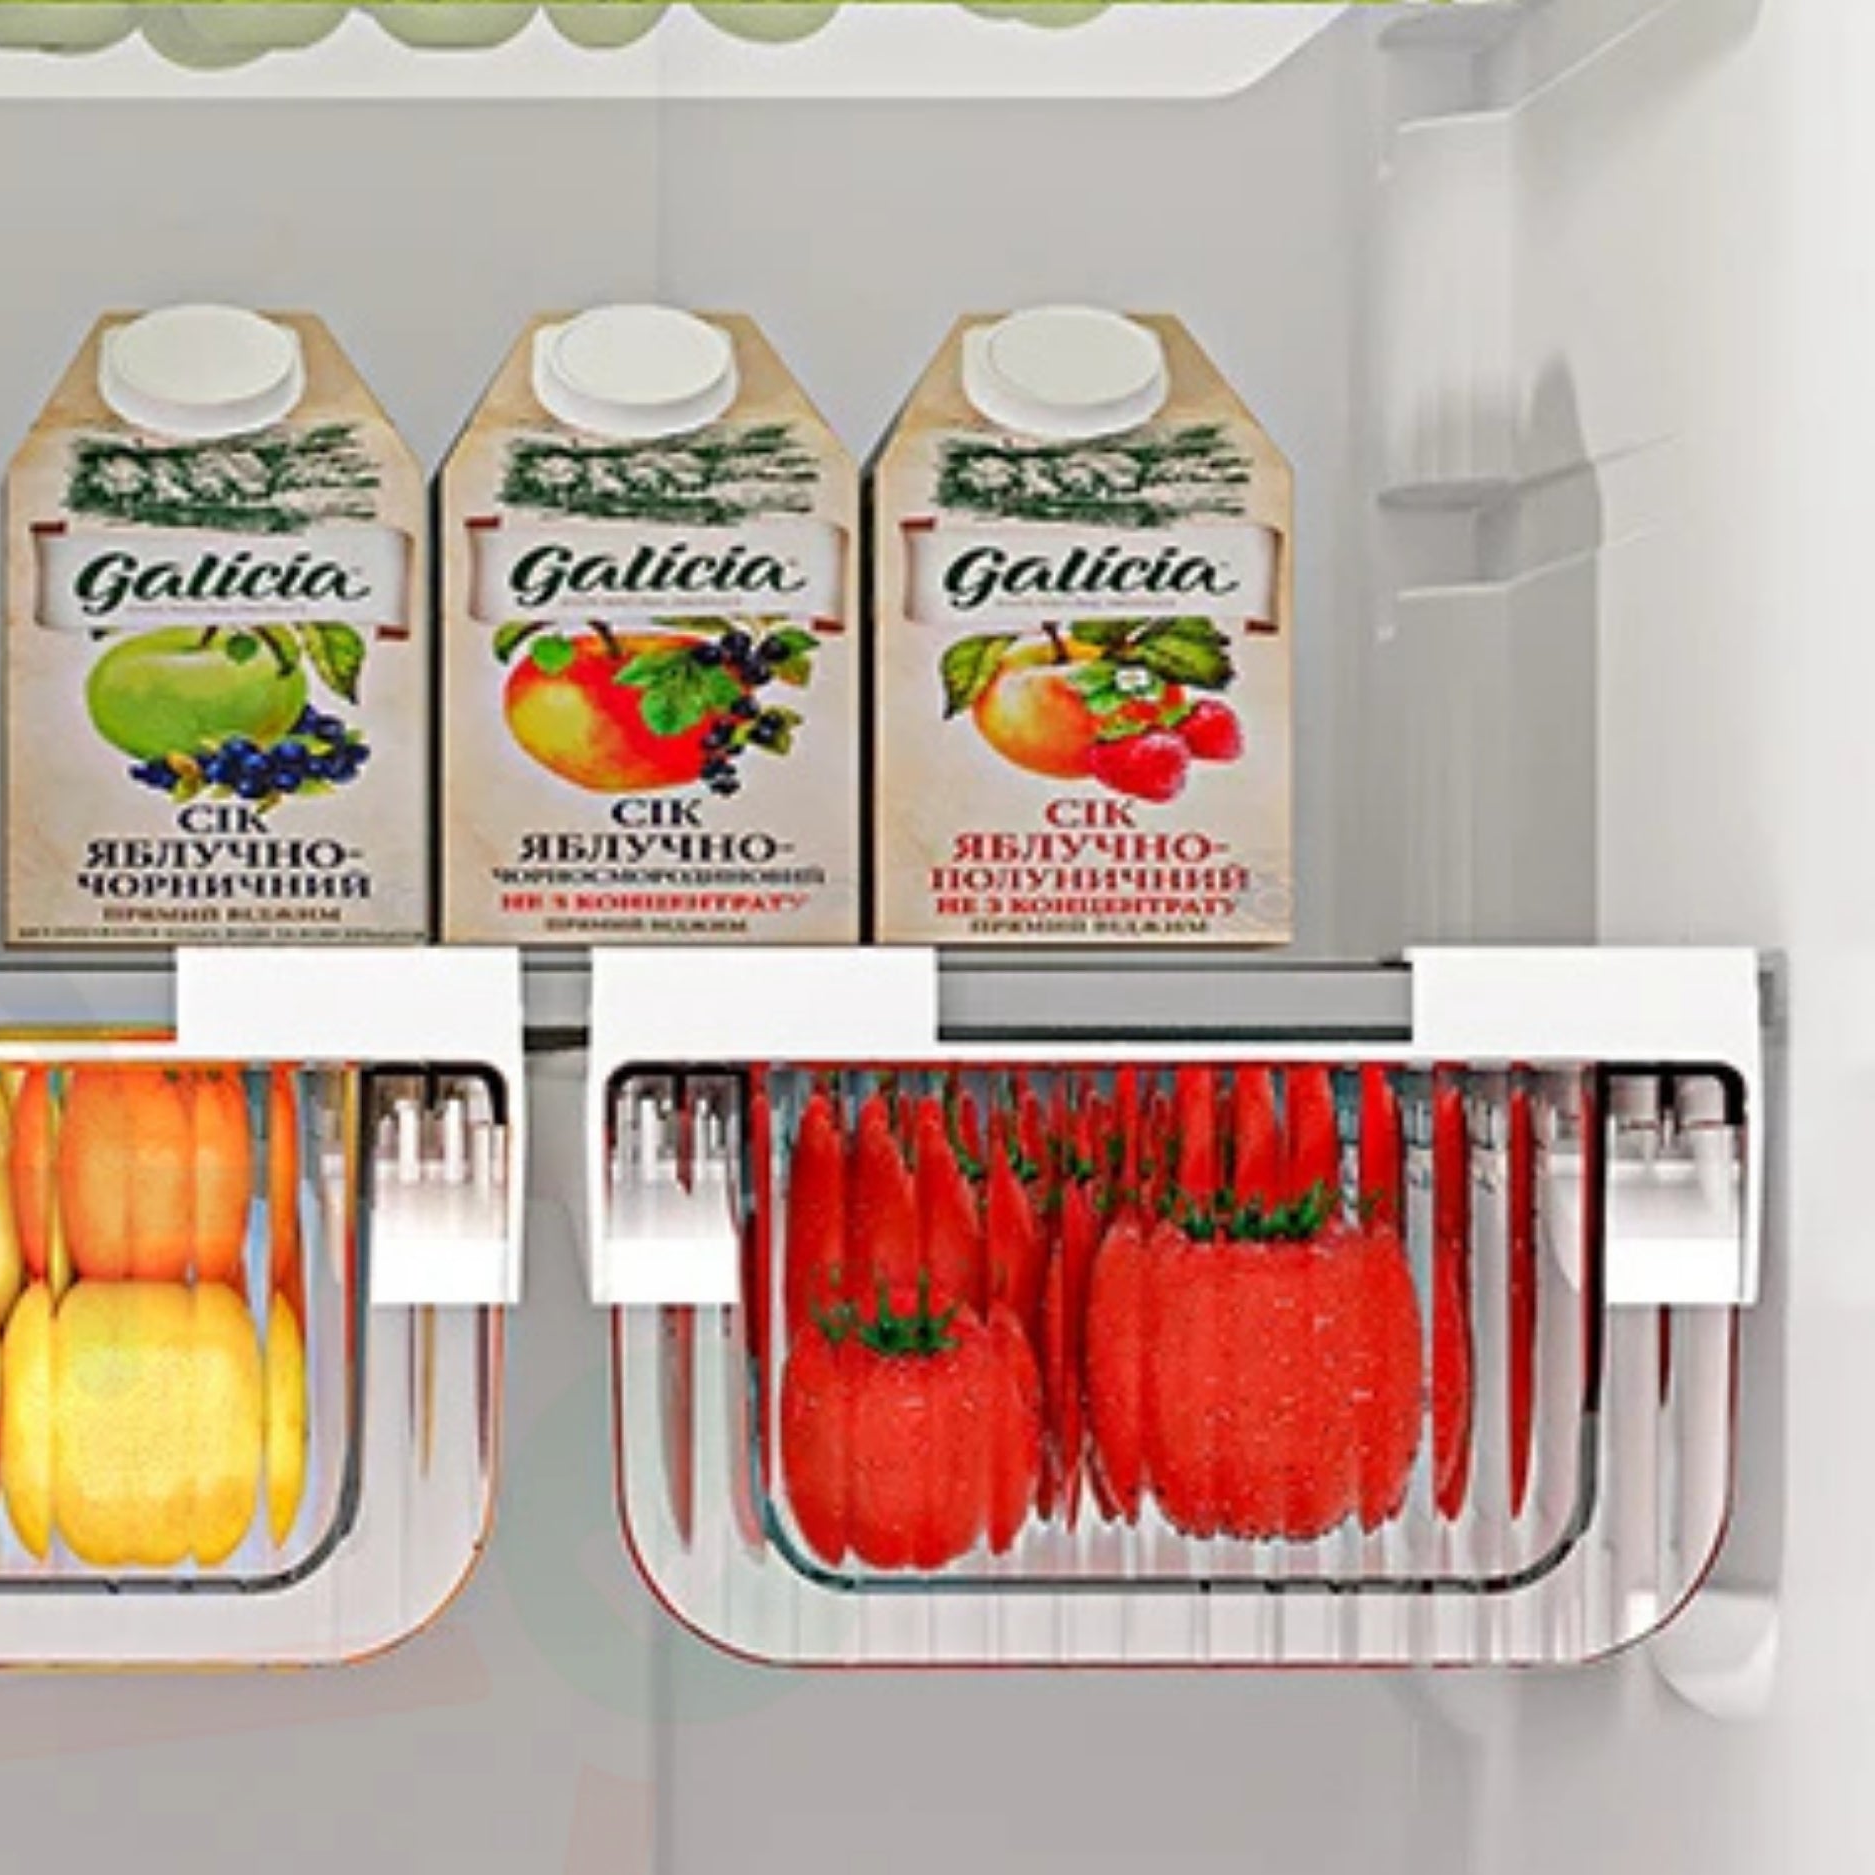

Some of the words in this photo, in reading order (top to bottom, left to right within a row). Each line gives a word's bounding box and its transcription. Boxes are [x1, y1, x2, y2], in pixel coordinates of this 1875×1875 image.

[74, 551, 371, 615] Galicia
[509, 544, 806, 607] Galicia
[943, 544, 1240, 609] Galicia
[177, 805, 270, 834] СІК
[611, 799, 703, 828] СІК
[1044, 800, 1136, 828] СІК
[87, 839, 362, 869] ЯБЛУЧНО-
[519, 833, 794, 863] ЯБЛУЧНО-
[953, 833, 1229, 863] ЯБЛУЧНО-
[77, 872, 371, 898] ЧОРНИЧНИЙ
[929, 864, 1250, 892] ПОЛУНИЧНИЙ
